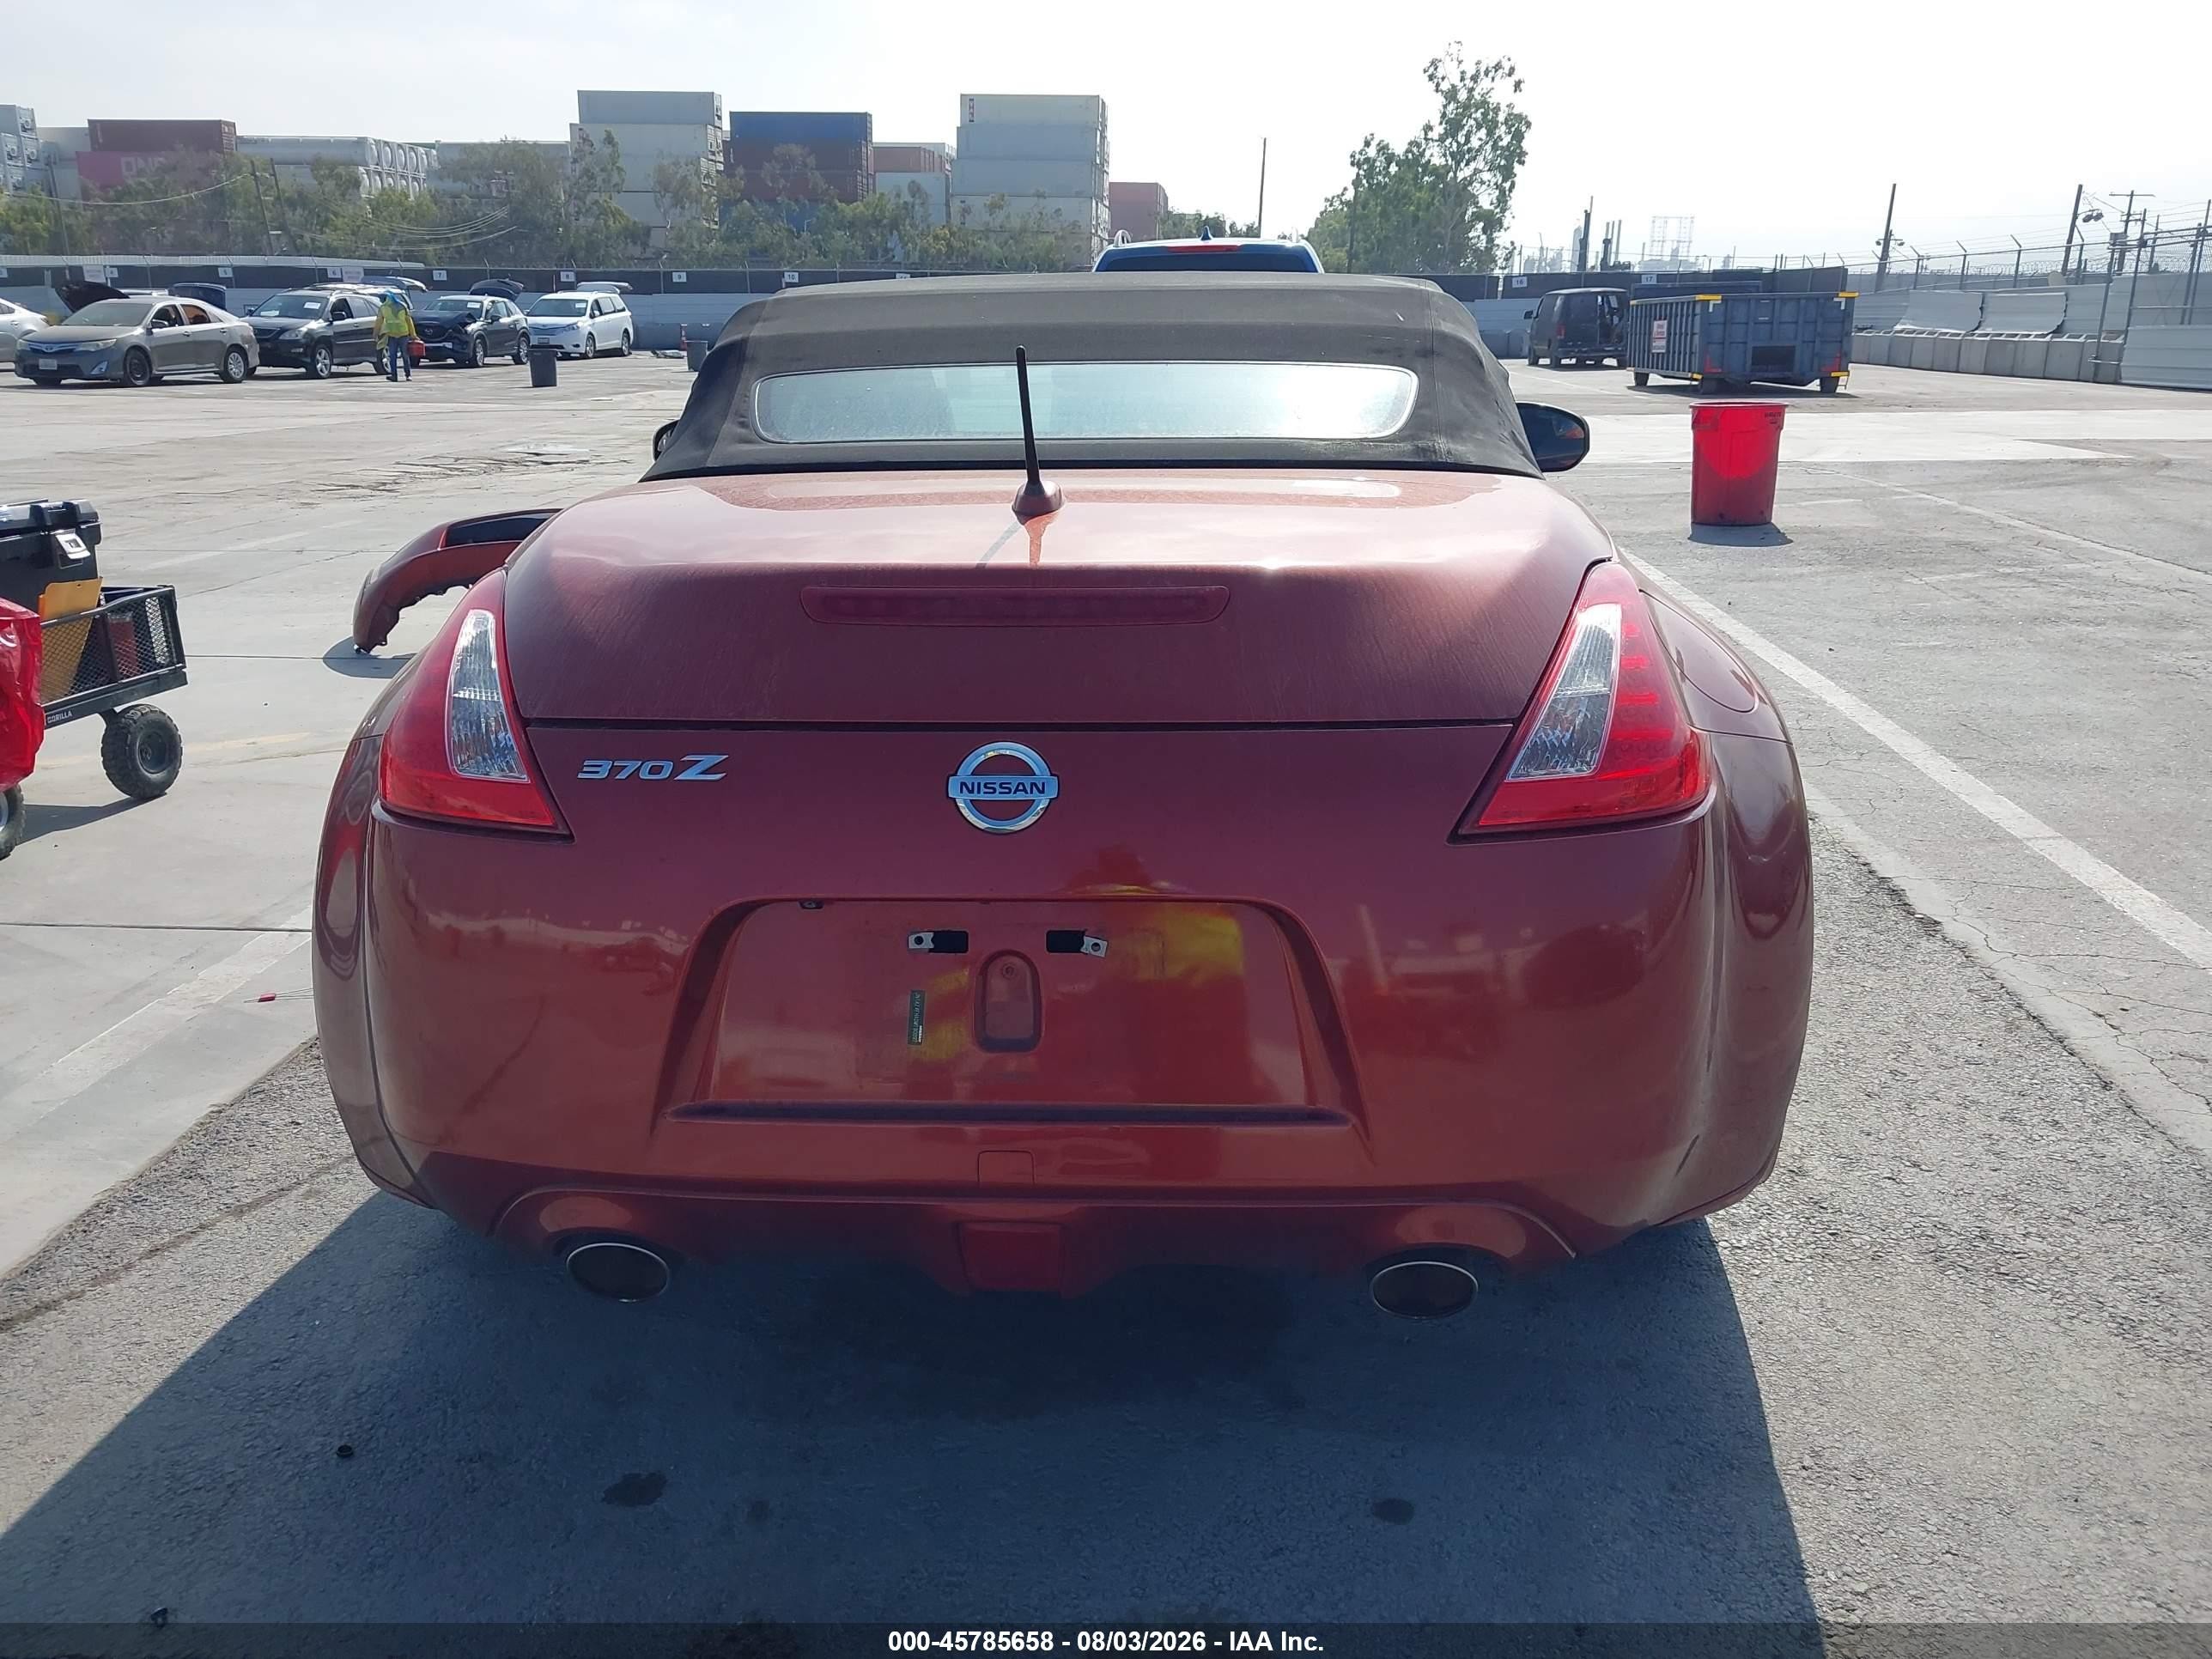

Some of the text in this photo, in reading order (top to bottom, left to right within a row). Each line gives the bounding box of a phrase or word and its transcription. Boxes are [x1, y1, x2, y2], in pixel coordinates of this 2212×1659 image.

[47, 710, 73, 724] GORILLA
[577, 755, 729, 781] 370Z
[959, 781, 1046, 795] NISSAN
